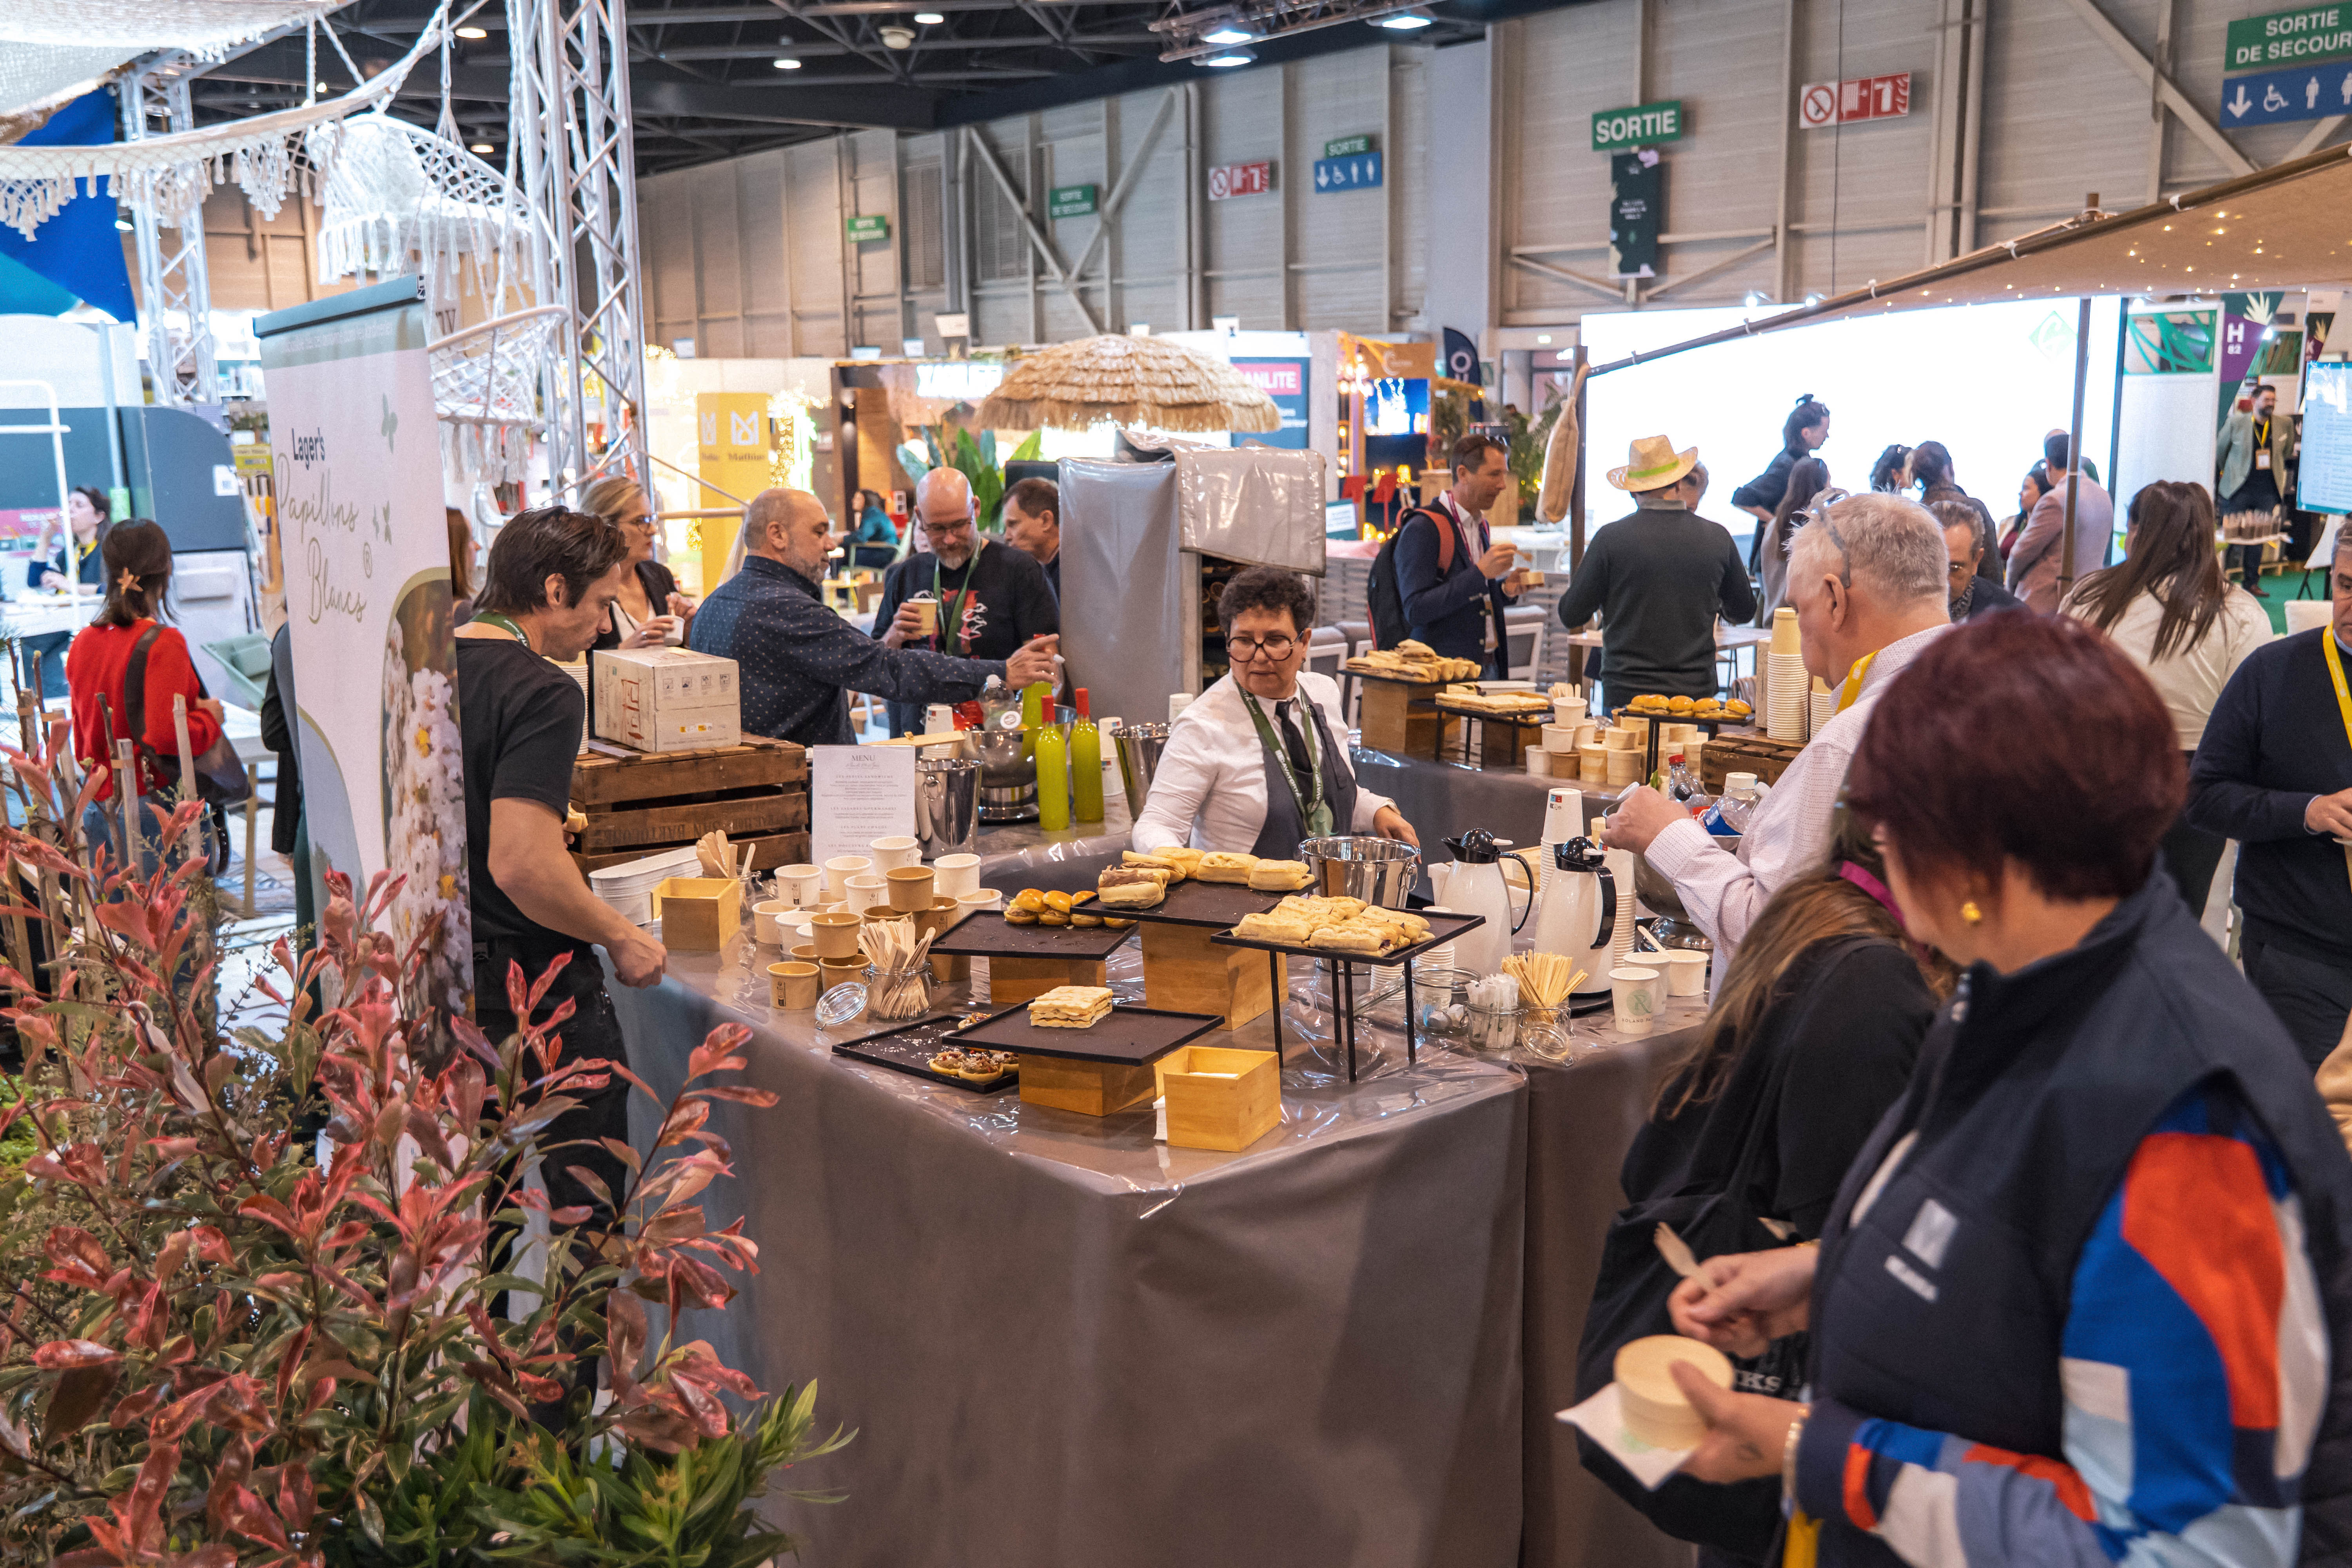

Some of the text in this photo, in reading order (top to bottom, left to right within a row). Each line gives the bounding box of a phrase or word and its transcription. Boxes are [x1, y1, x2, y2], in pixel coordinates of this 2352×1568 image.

[2265, 9, 2339, 36] SORTIE
[2236, 31, 2352, 64] DE SECOUR
[1595, 110, 1676, 143] SORTIE
[1328, 139, 1365, 156] SORTIE
[2227, 322, 2245, 343] H
[1244, 371, 1297, 389] ANLITE
[291, 427, 325, 470] Lager's
[307, 537, 367, 624] Blancs
